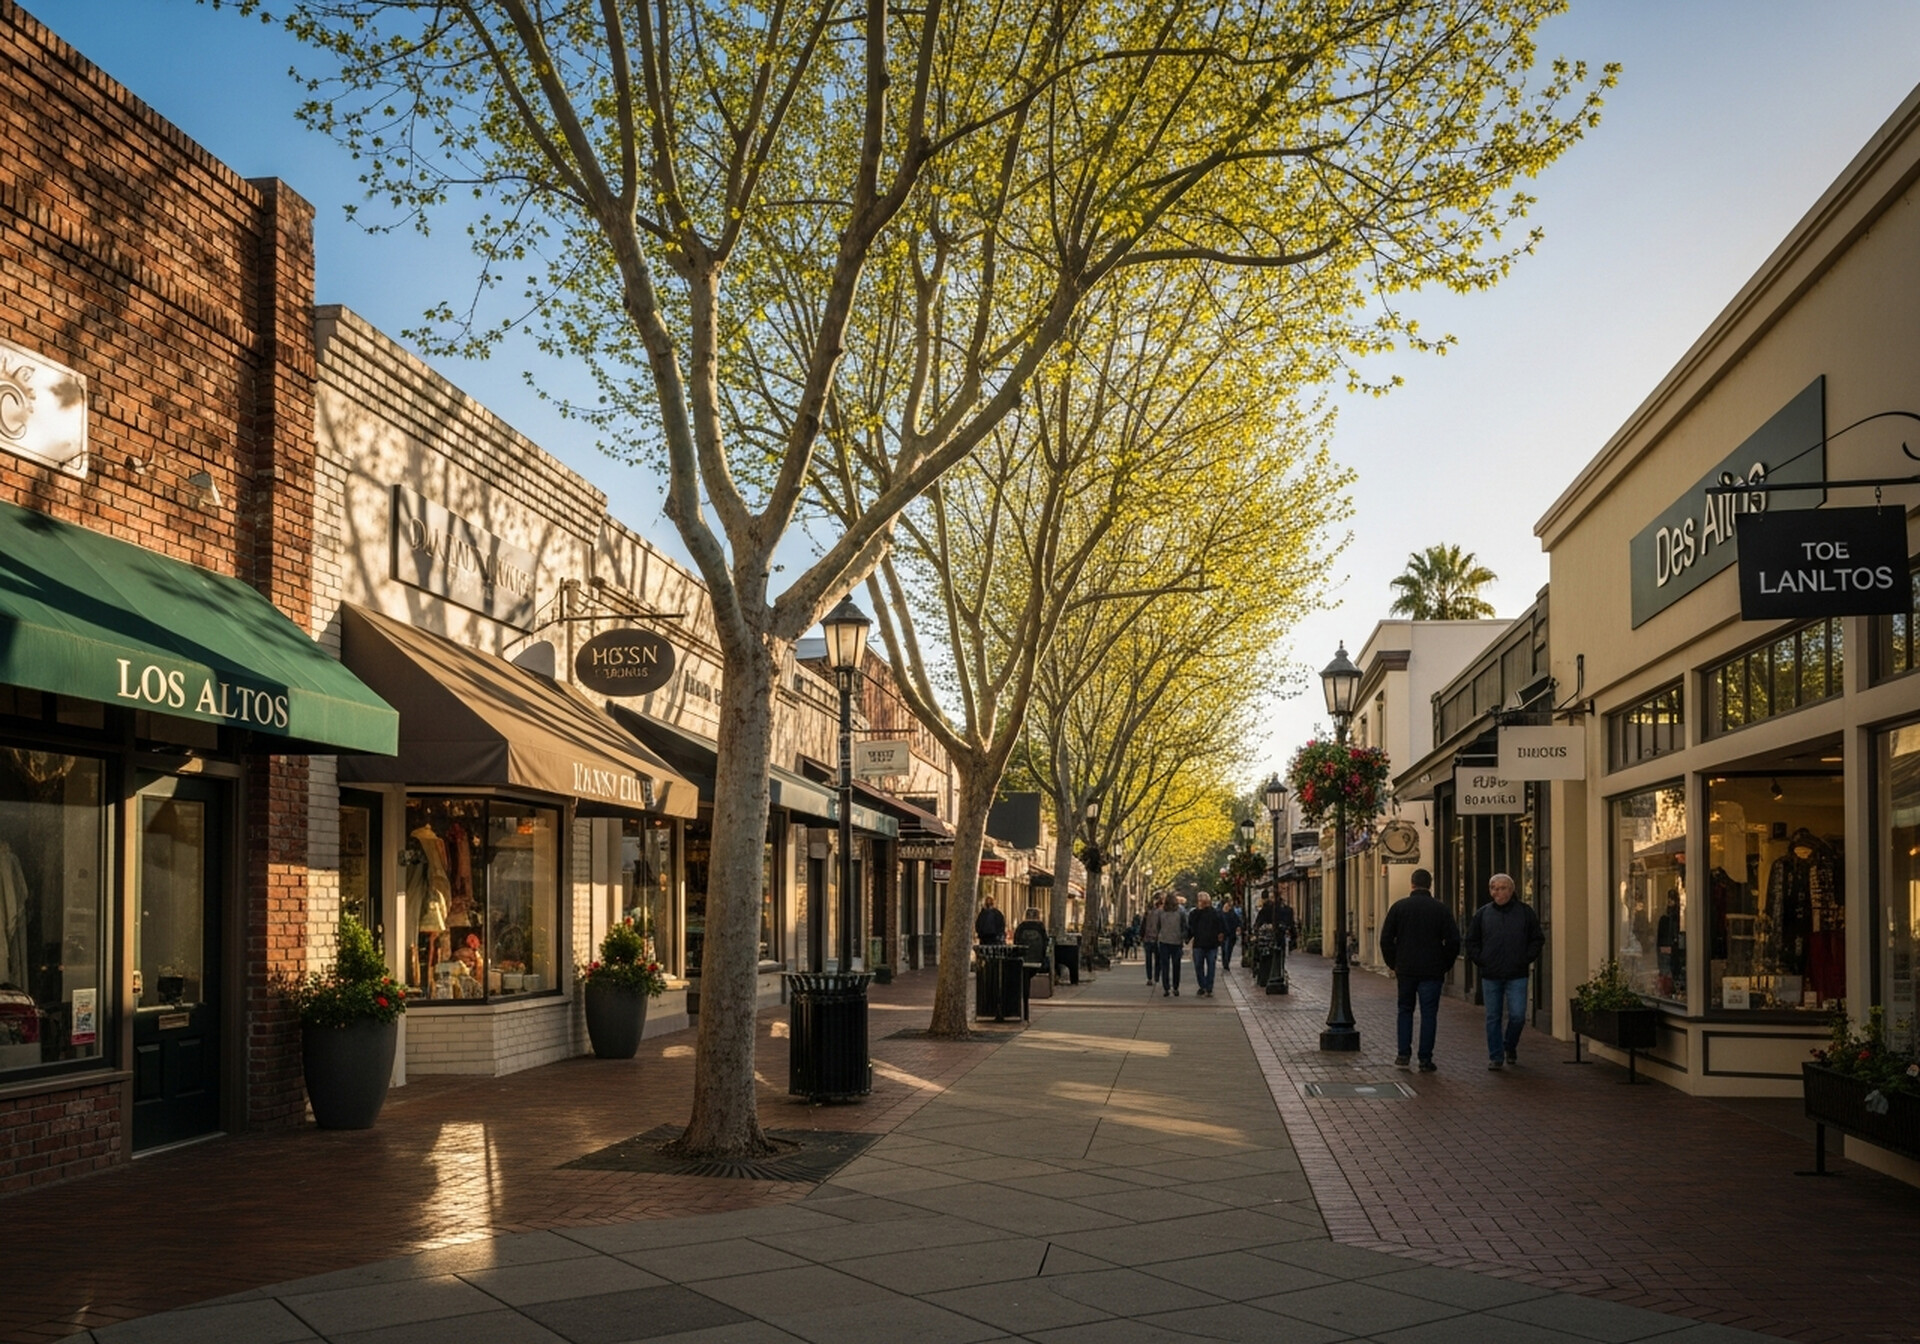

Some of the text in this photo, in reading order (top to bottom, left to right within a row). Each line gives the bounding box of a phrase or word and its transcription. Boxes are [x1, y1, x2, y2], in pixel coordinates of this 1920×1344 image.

[1656, 517, 1694, 588] Des
[1801, 542, 1850, 561] TOE
[1759, 566, 1894, 595] LANLTOS
[117, 658, 288, 728] LOS ALTOS
